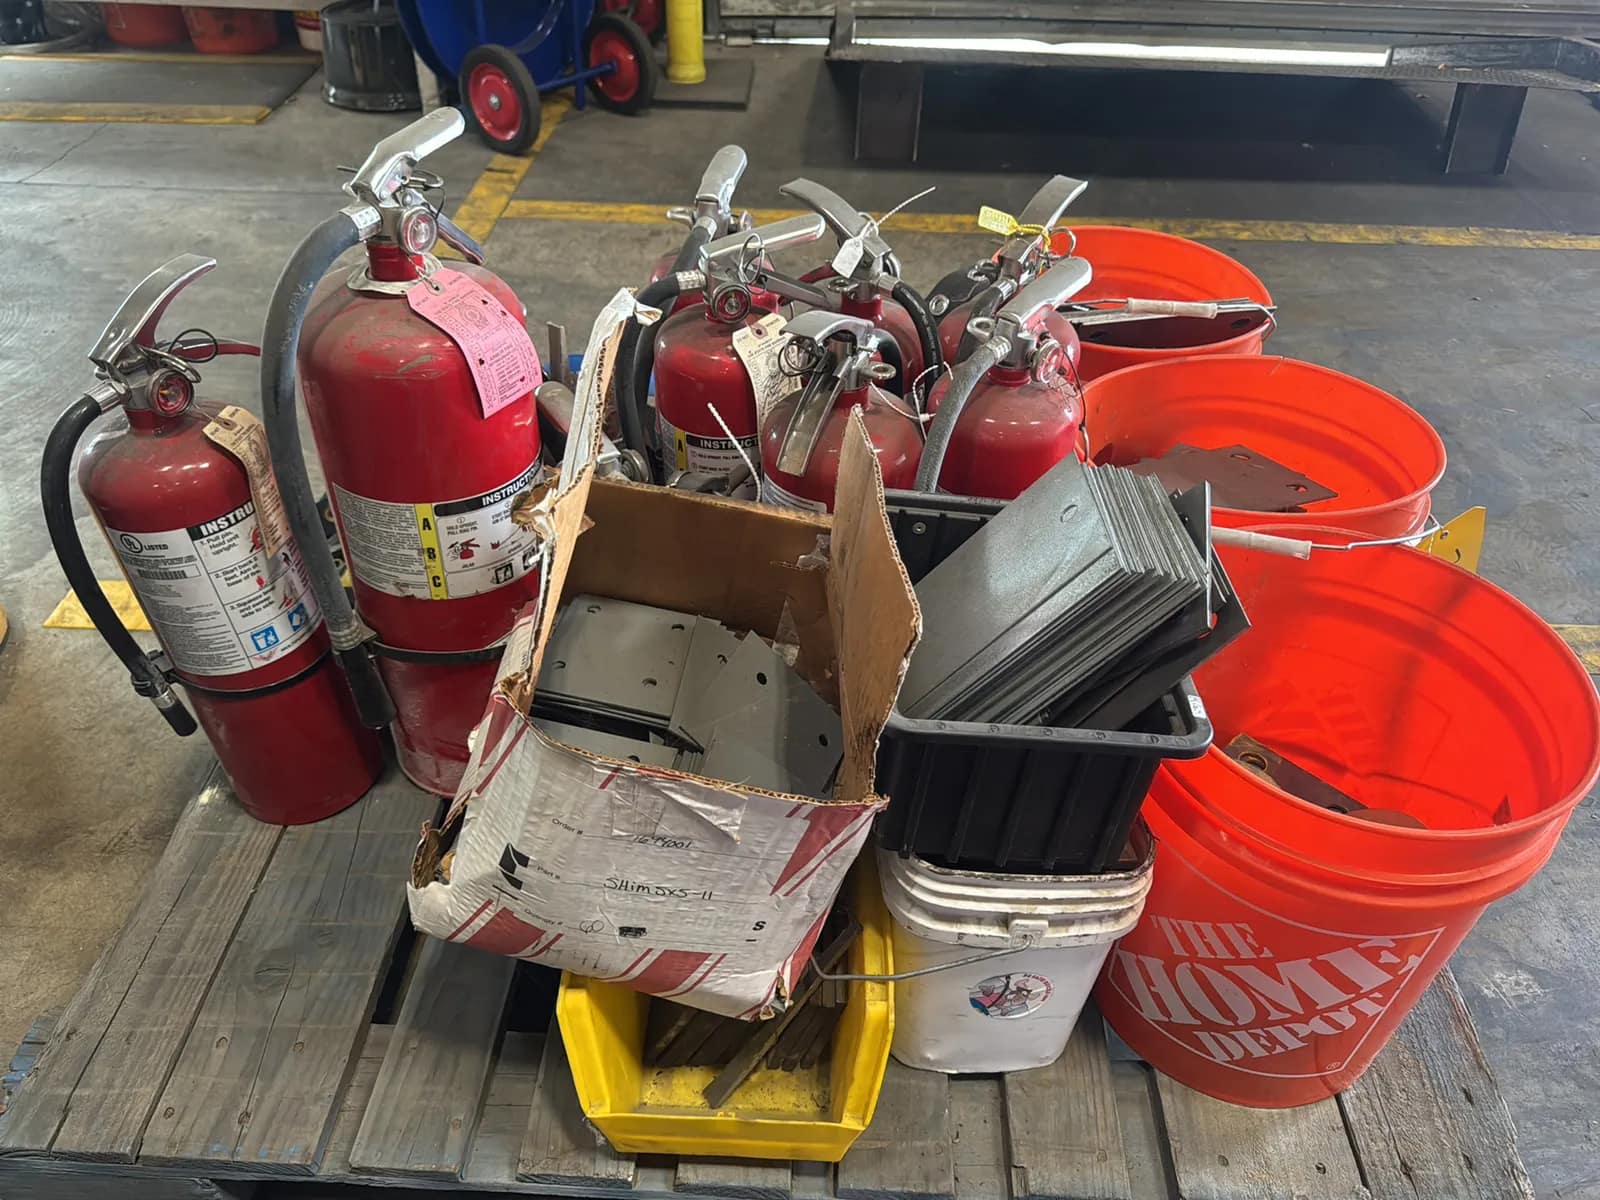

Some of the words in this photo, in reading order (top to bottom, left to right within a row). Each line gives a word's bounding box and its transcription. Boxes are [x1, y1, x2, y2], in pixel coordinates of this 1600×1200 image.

[677, 439, 684, 452] A
[422, 518, 432, 531] A
[210, 540, 226, 549] Hold
[427, 547, 436, 560] B
[432, 575, 442, 588] C
[552, 818, 575, 832] Order
[537, 865, 554, 877] Part
[752, 920, 767, 932] S
[1150, 915, 1273, 959] THE
[1115, 936, 1421, 1027] HOME
[1194, 992, 1389, 1063] DEPOT
